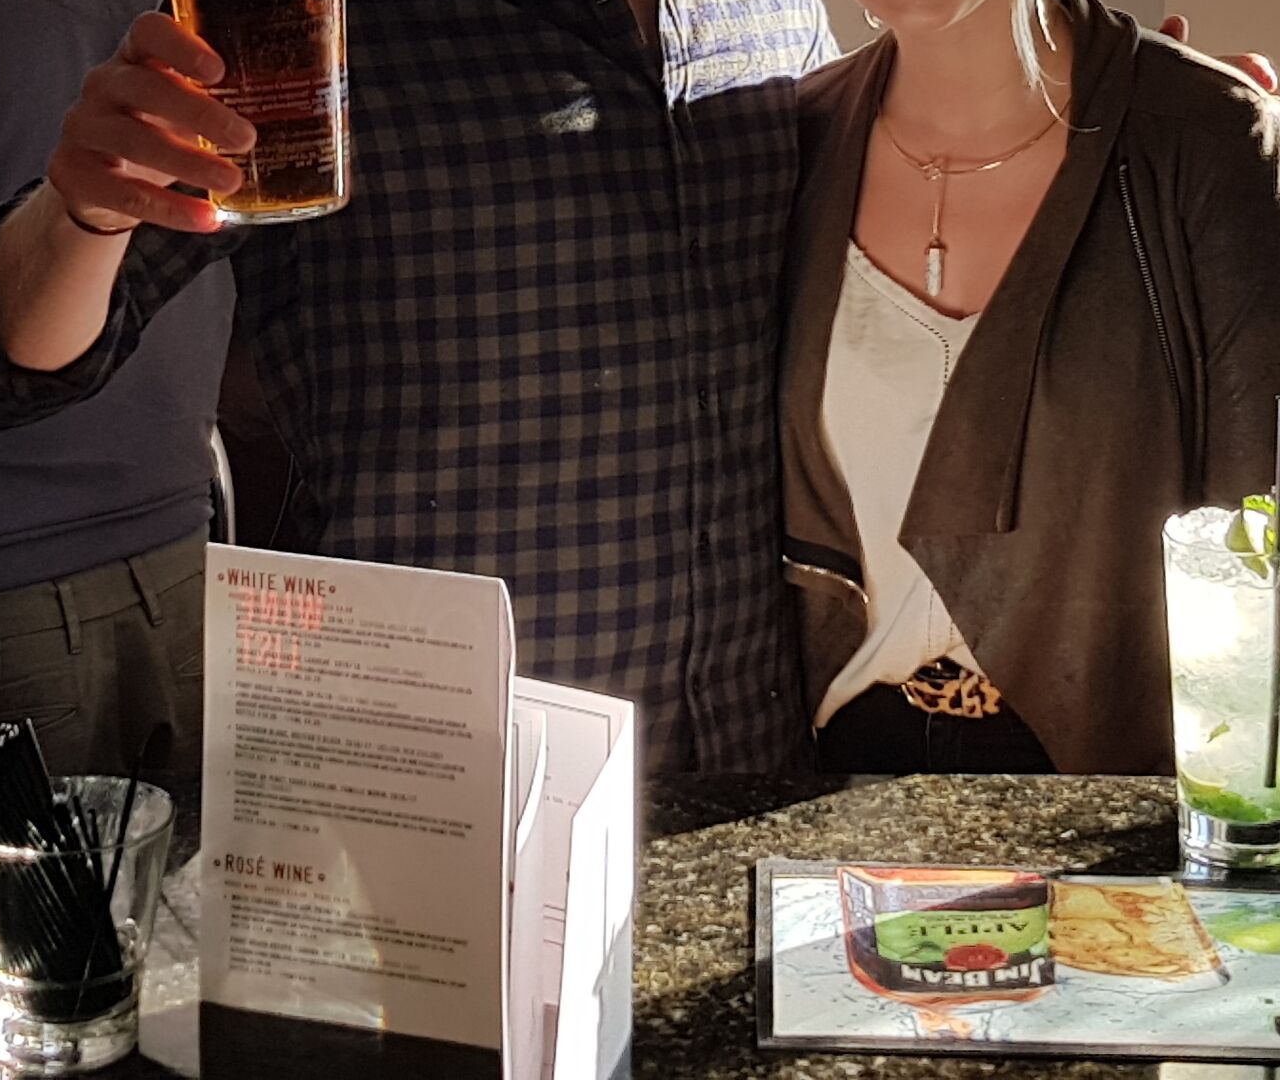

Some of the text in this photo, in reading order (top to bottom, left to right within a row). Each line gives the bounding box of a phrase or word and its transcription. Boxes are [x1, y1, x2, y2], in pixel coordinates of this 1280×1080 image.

[227, 569, 327, 597] WHITE WINE
[224, 853, 314, 884] ROSÉ WINE
[906, 923, 1028, 937] APPLE
[900, 956, 1047, 987] JIM BEAM
